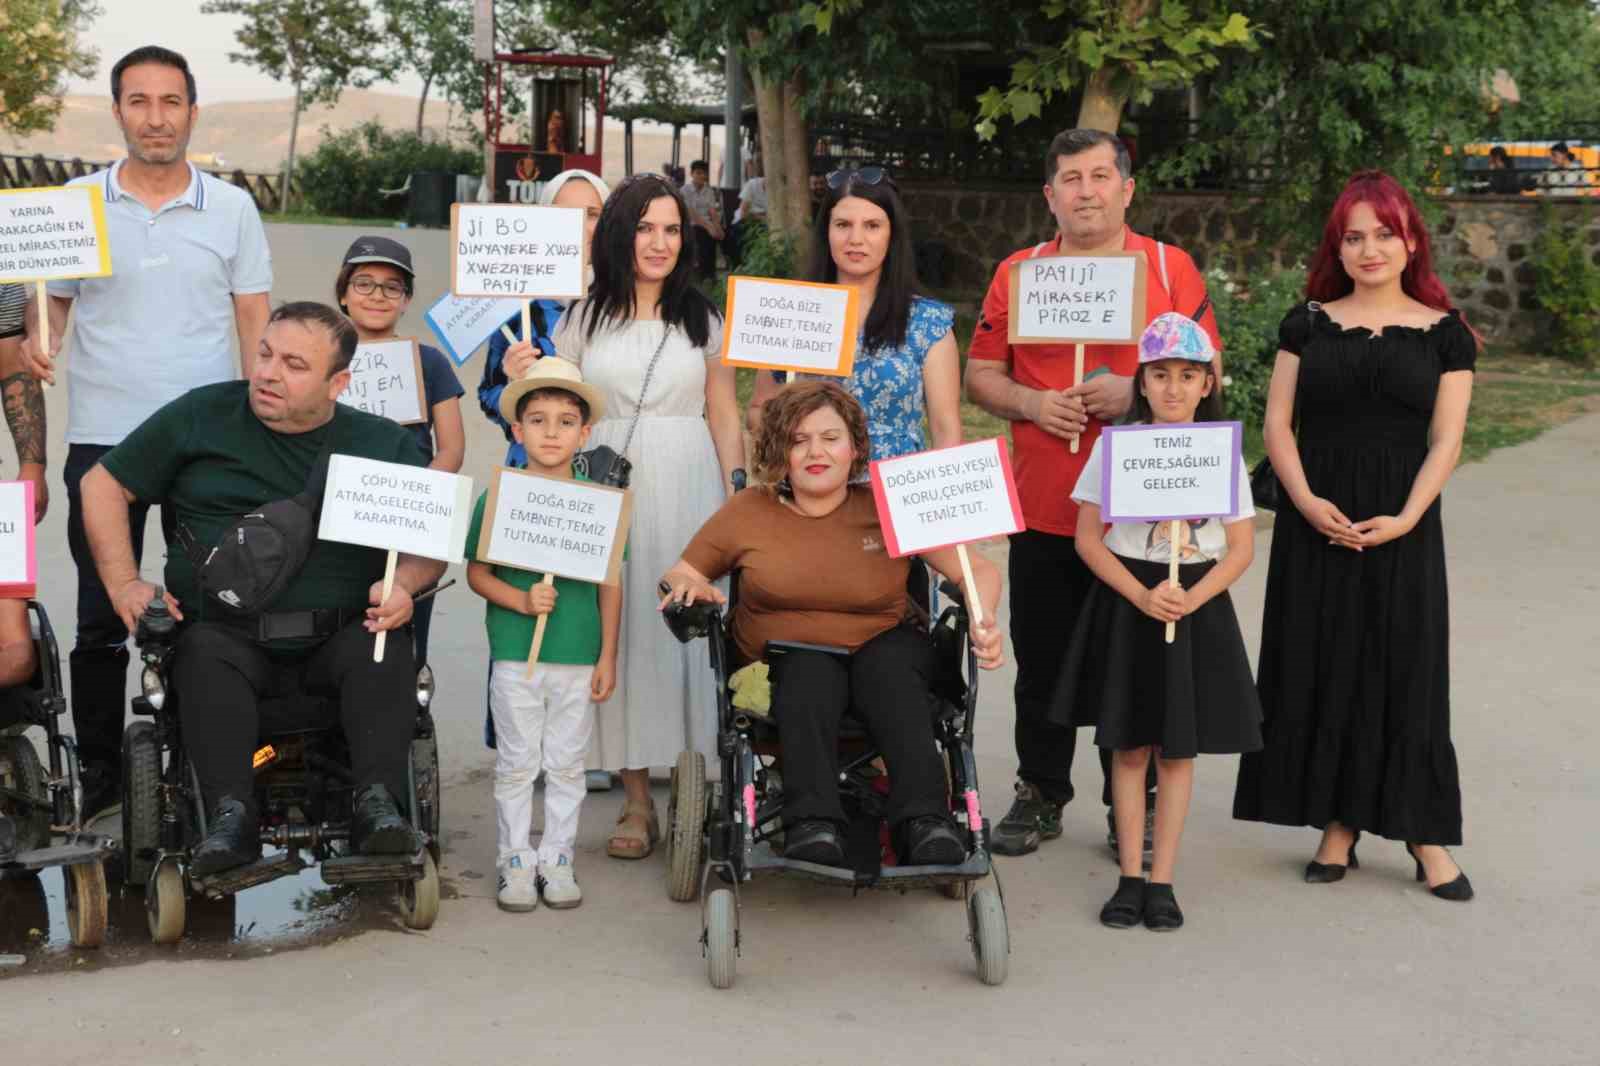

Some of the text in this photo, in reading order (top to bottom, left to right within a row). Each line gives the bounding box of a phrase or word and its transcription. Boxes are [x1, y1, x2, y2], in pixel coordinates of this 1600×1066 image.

[9, 205, 55, 217] YARINA
[67, 220, 84, 232] EN
[495, 217, 528, 236] BO
[759, 295, 823, 314] DOĞA BİZE
[1101, 309, 1116, 323] E
[739, 332, 833, 353] TUTMAK İBADET
[377, 374, 405, 392] EM
[1153, 434, 1193, 449] TEMİZ
[1122, 454, 1221, 472] ÇEVRE,SAĞLIKLI
[401, 479, 433, 495] YERE
[886, 467, 937, 489] DOĞAYI
[1143, 477, 1200, 490] GELECEK.
[527, 491, 596, 515] DOĞA BİZE
[917, 500, 989, 524] TEMİZ TUT.
[503, 527, 607, 557] TUTMAK İBADET
